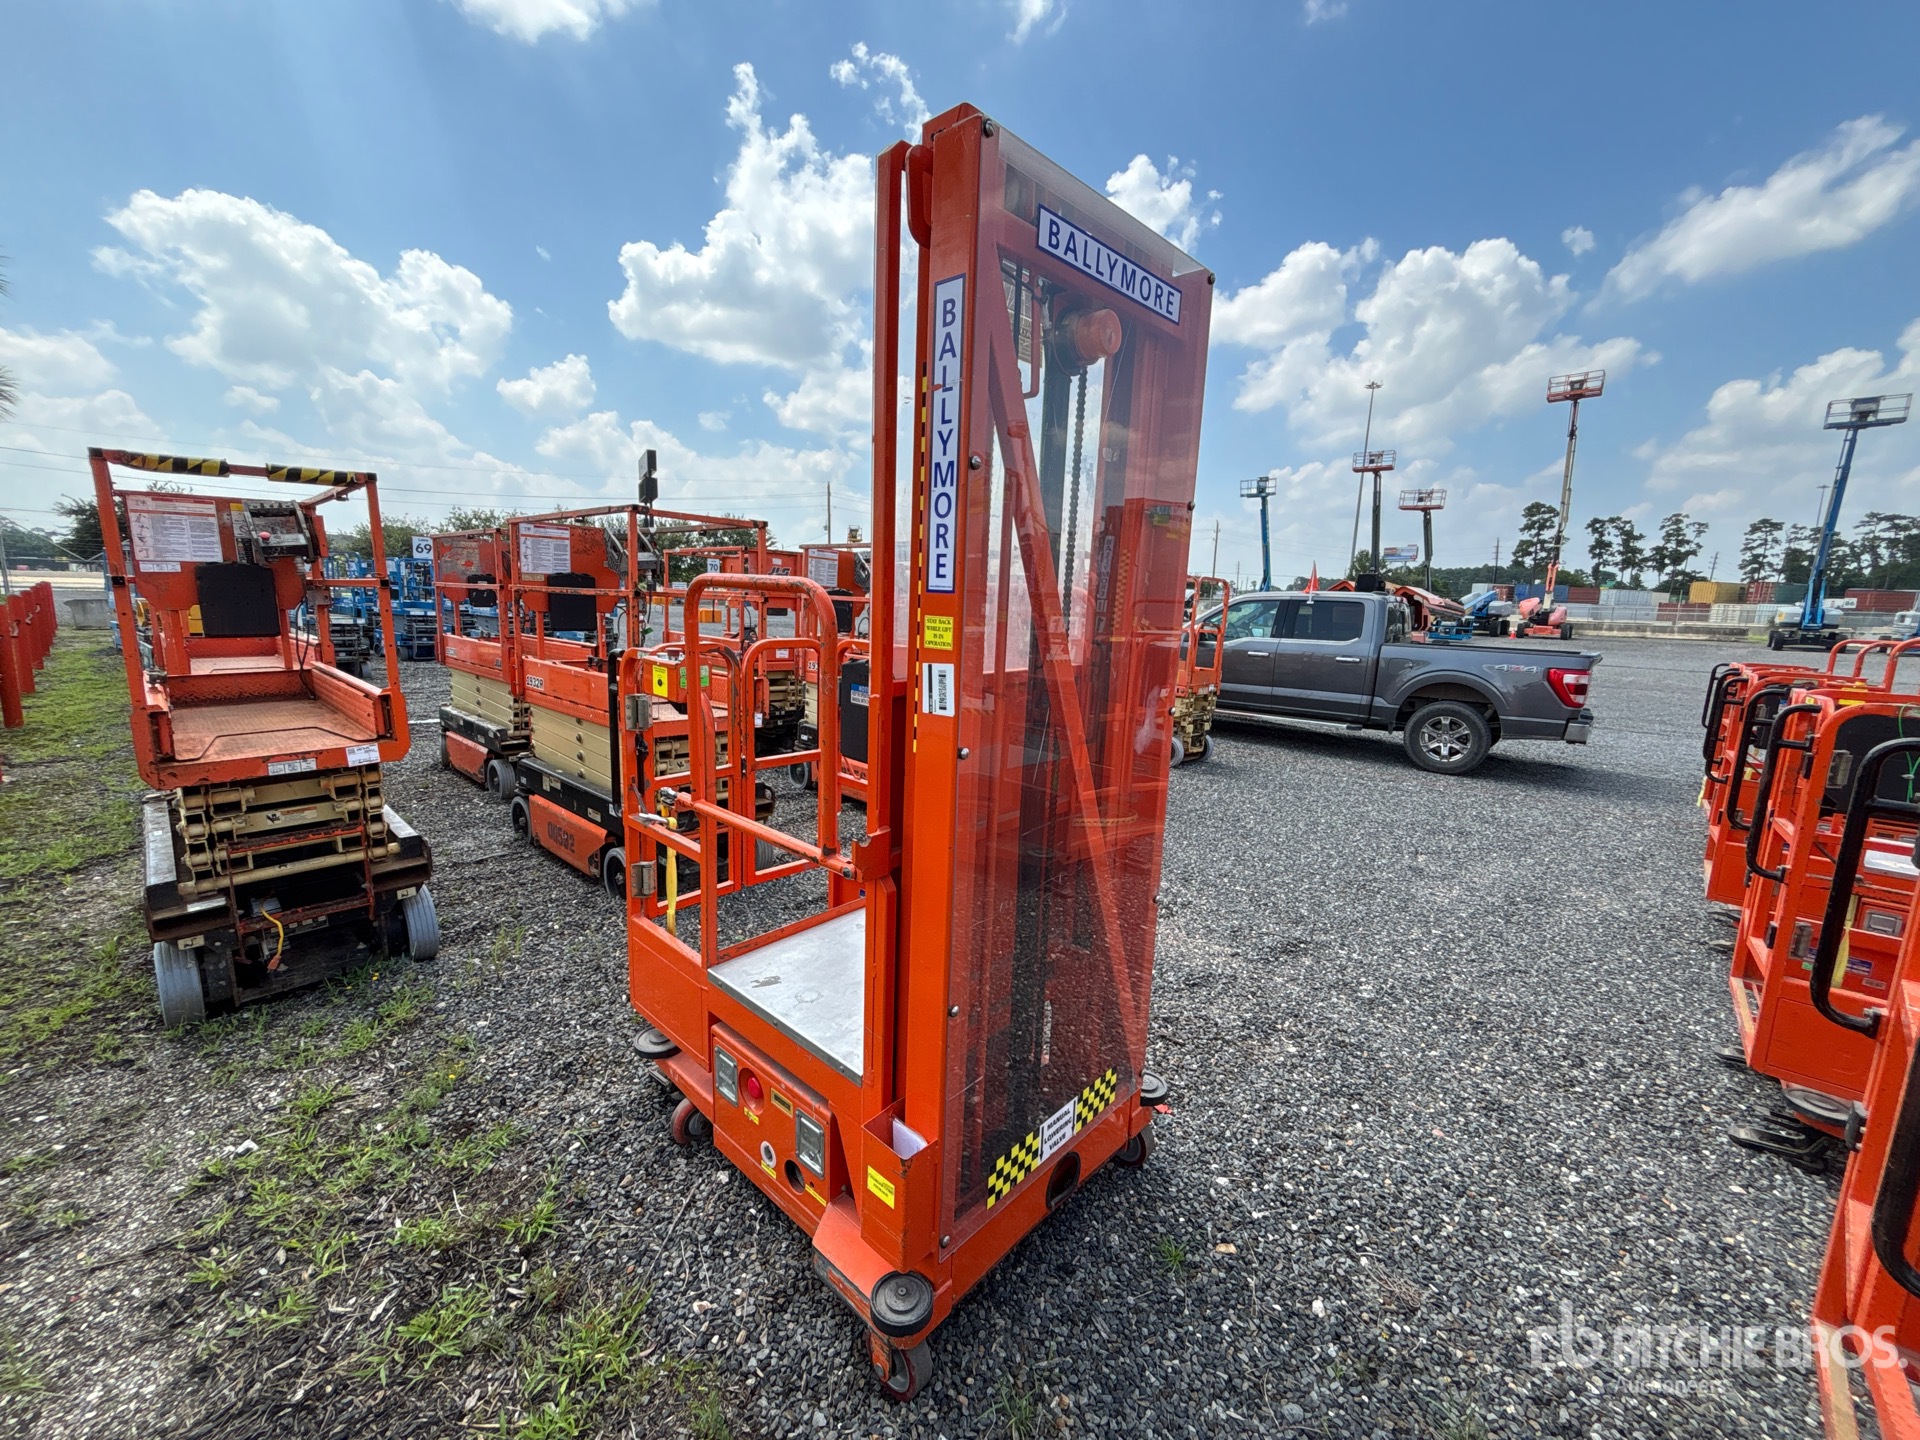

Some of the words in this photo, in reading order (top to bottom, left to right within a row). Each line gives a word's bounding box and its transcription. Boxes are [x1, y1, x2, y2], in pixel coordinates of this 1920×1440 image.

[1048, 217, 1175, 316] BALLYMORE
[933, 297, 957, 579] BALLYMORE
[415, 543, 432, 554] 69
[709, 563, 719, 571] 70
[768, 567, 791, 576] JLG
[925, 640, 952, 648] OPERATION
[526, 676, 544, 690] 1932R
[1047, 1108, 1070, 1131] MANUAL
[1044, 1116, 1073, 1145] LOWERING
[1049, 1132, 1066, 1150] VALVE
